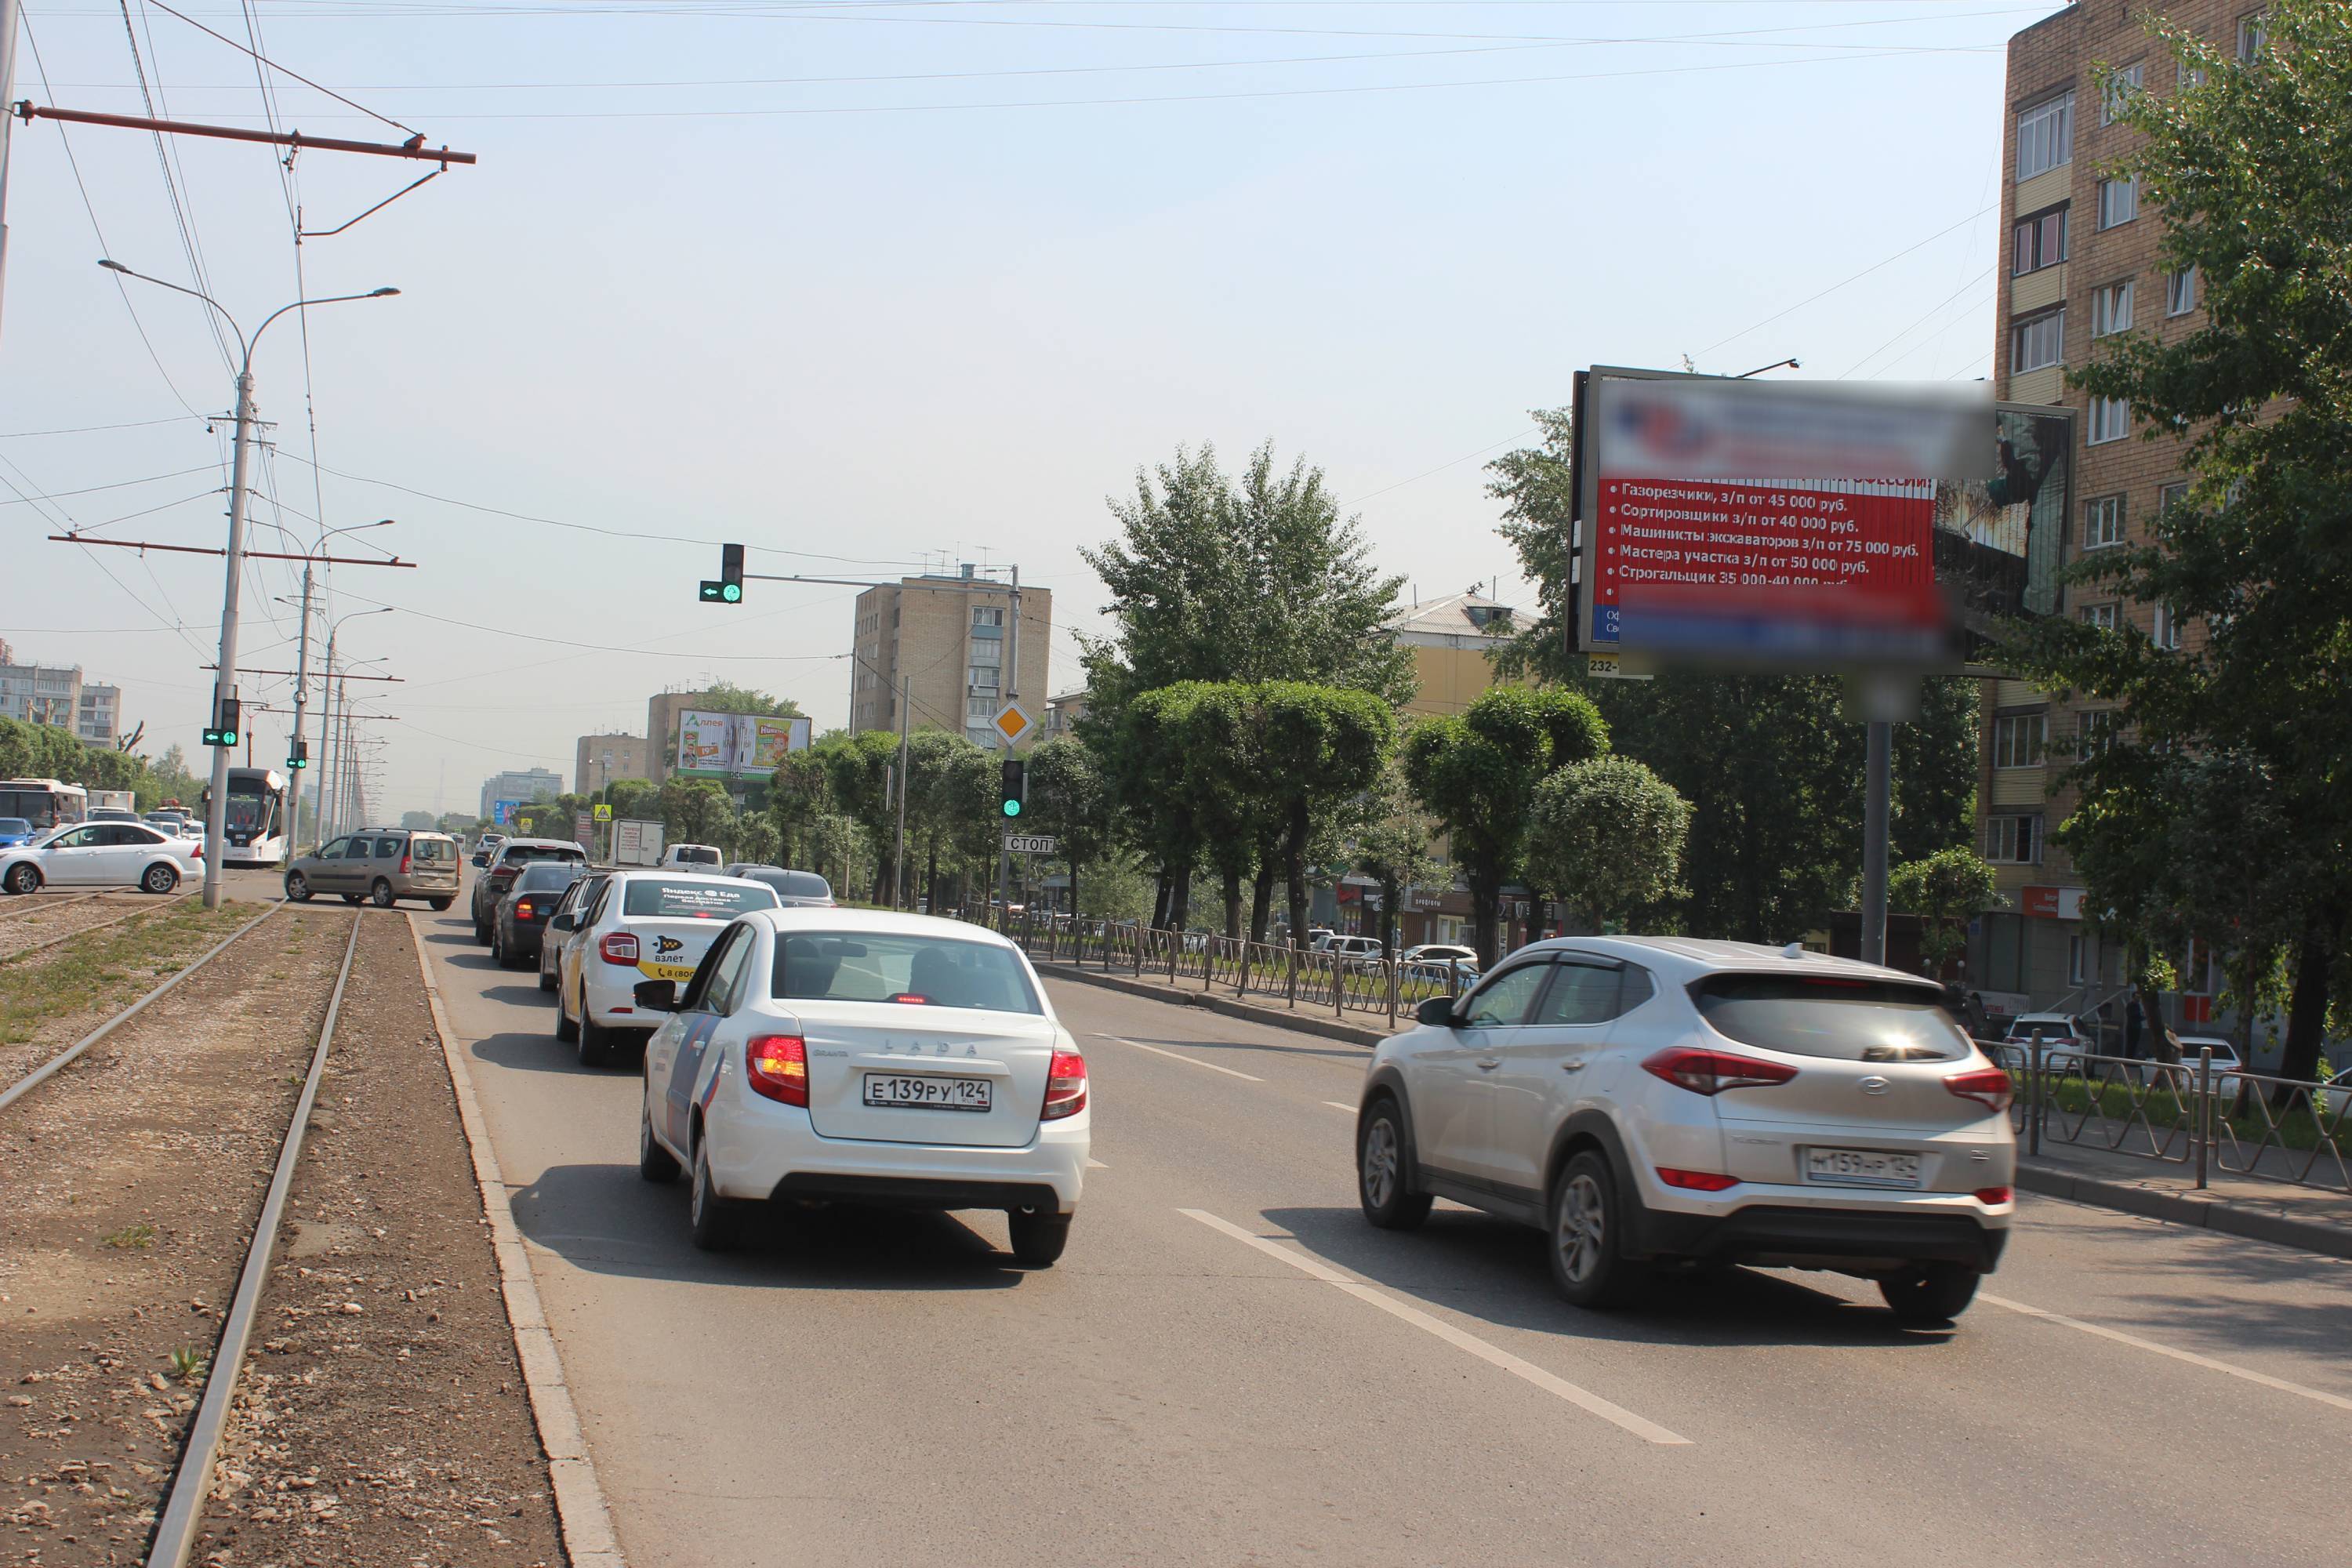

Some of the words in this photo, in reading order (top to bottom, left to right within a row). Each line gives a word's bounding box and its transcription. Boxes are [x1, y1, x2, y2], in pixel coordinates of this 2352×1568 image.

[1621, 482, 1717, 503] Газорезчики,
[1721, 491, 1744, 505] з/п
[1748, 495, 1766, 505] от
[1769, 495, 1785, 506] 45
[1789, 495, 1816, 508] 000
[1820, 499, 1848, 513] руб.
[1621, 503, 1728, 523] Сортировщики
[1732, 513, 1757, 526] з/п
[1761, 516, 1777, 526] от
[1780, 515, 1797, 528] 40
[1801, 517, 1827, 529] 000
[1831, 520, 1859, 533] руб.
[1621, 523, 1704, 541] Машинисты
[1707, 529, 1799, 550] экскаваторов
[1802, 537, 1825, 551] з/п
[1828, 541, 1842, 550] от
[1846, 540, 1862, 553] 75
[1865, 542, 1889, 554] 000
[1892, 544, 1919, 557] руб.
[1619, 565, 1715, 583] Строгальщик
[1719, 572, 1737, 584] 35
[1620, 544, 1680, 561] Мастера
[1685, 551, 1739, 564] участка
[1743, 554, 1768, 568] з/п
[1771, 557, 1788, 568] от
[1791, 556, 1808, 569] 50
[1812, 557, 1838, 571] 000
[1842, 561, 1870, 575] руб.
[1011, 837, 1049, 851] СТОП
[886, 1040, 977, 1055] LADA
